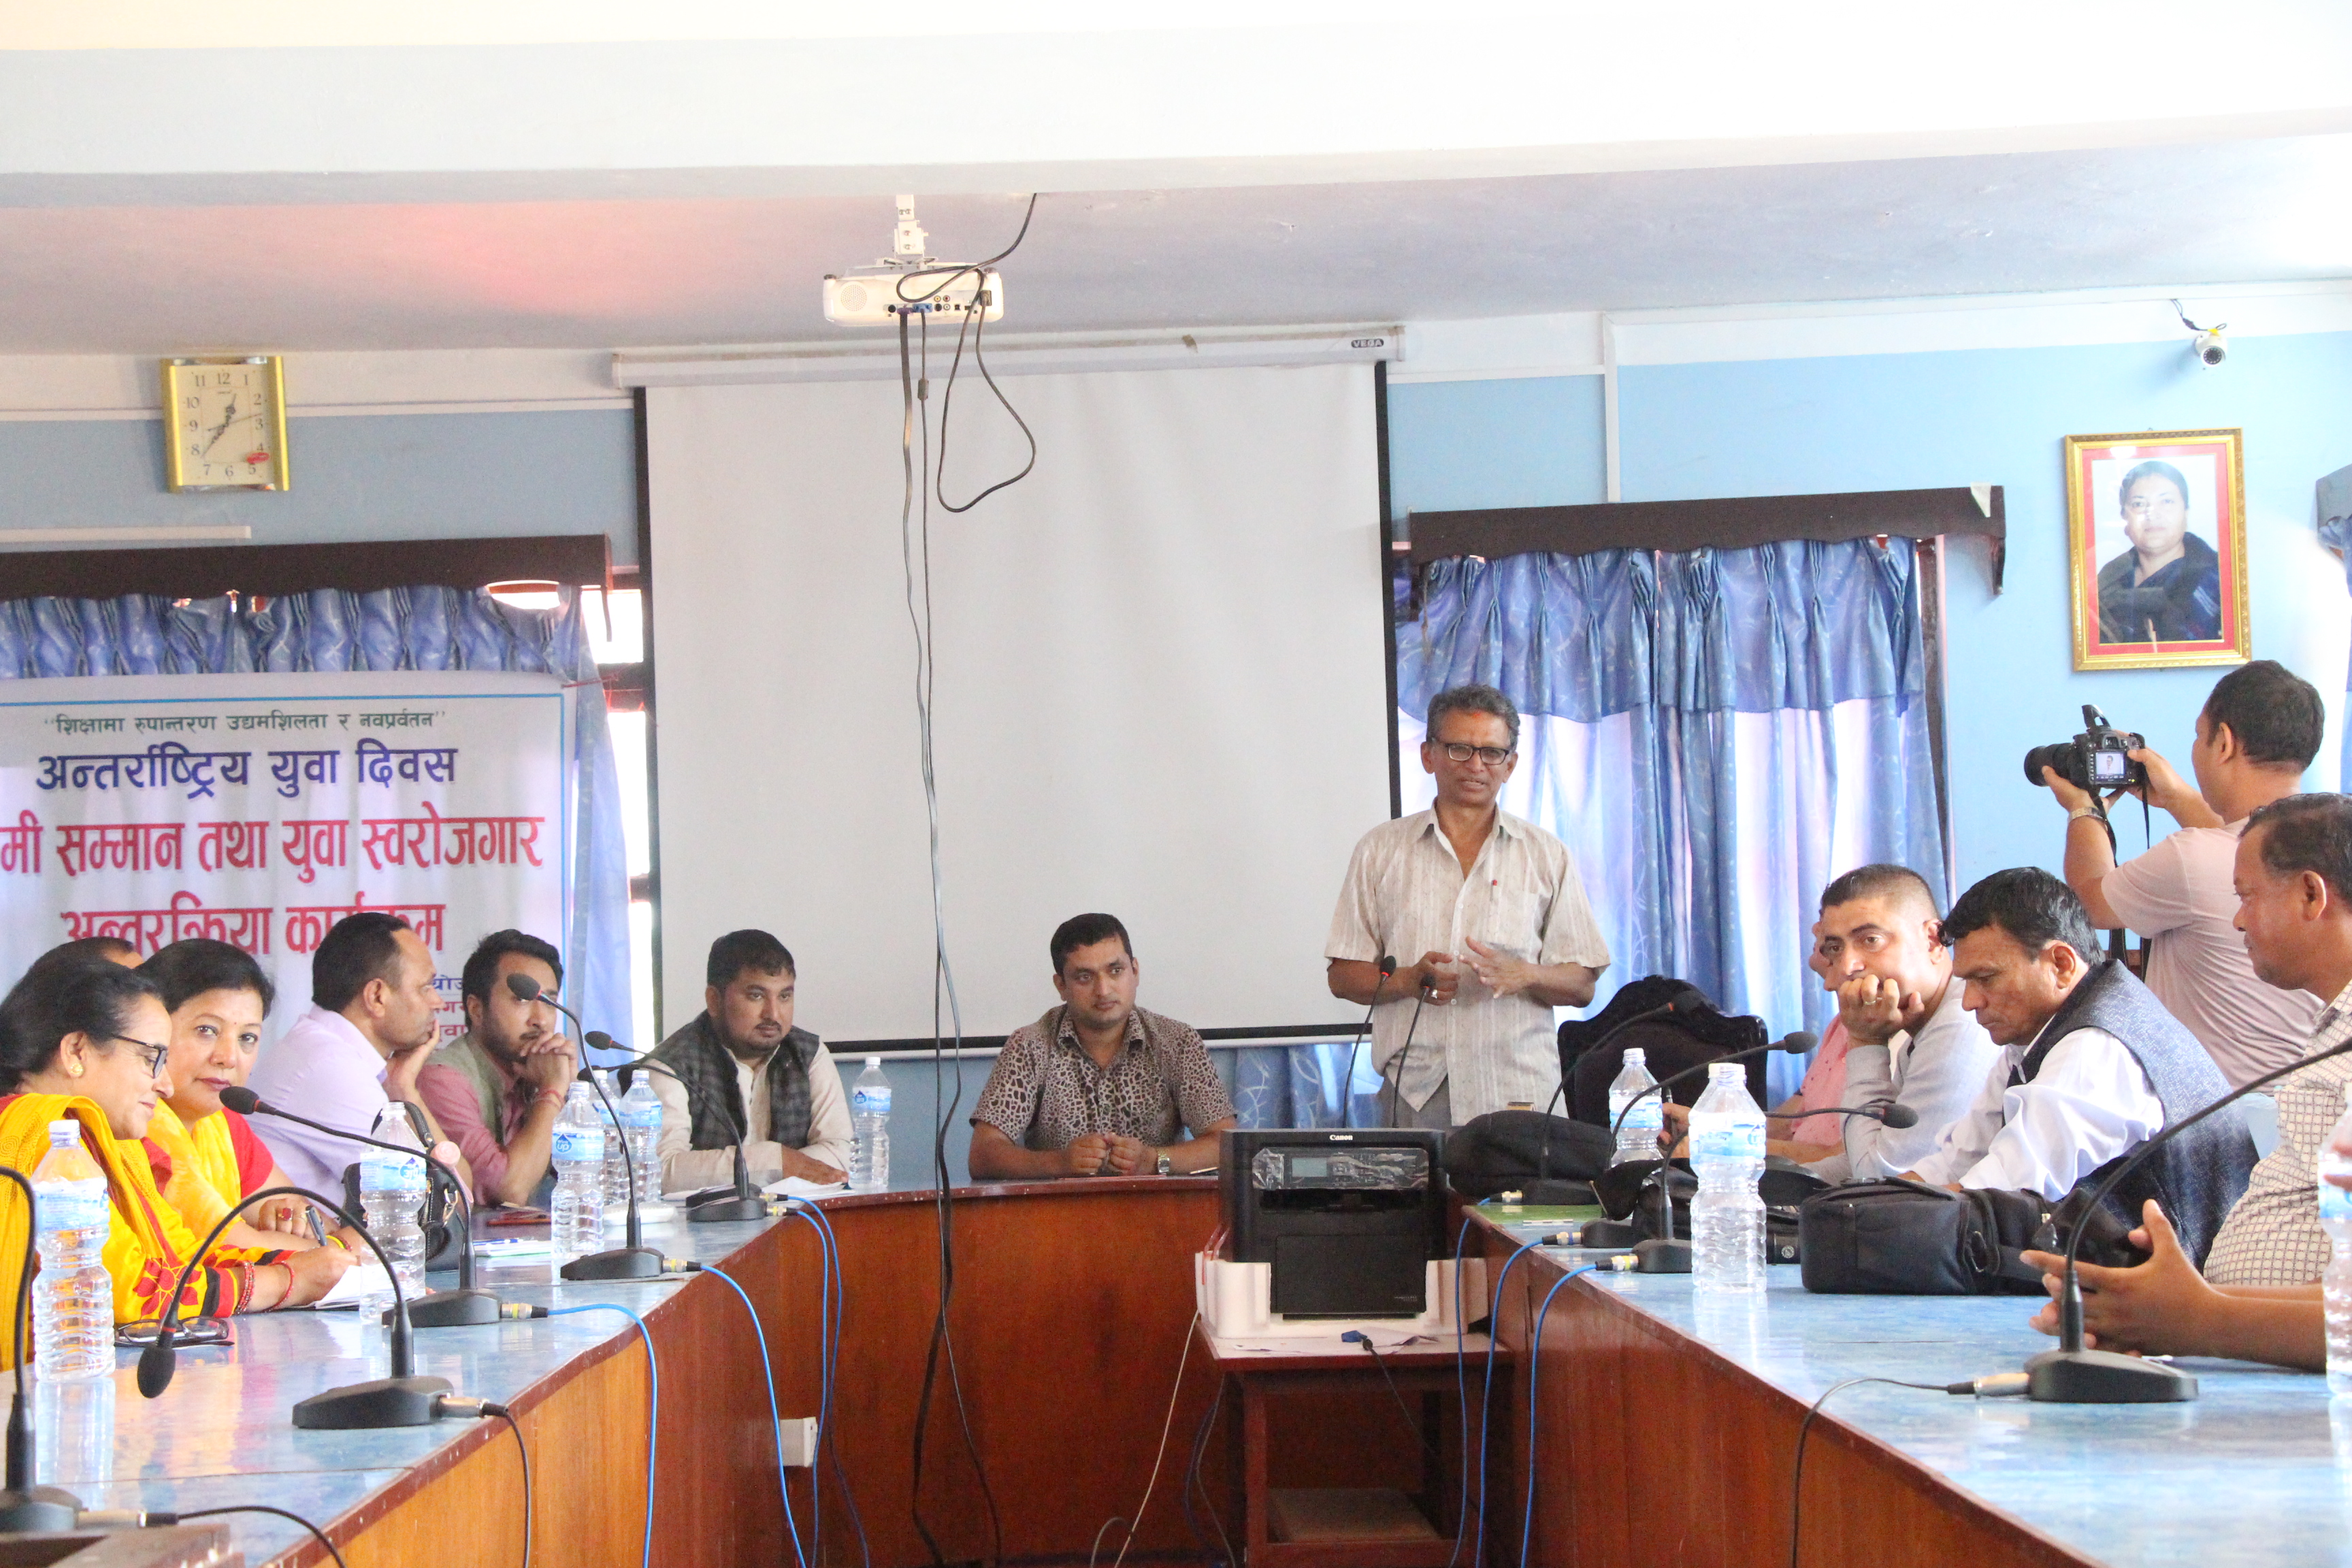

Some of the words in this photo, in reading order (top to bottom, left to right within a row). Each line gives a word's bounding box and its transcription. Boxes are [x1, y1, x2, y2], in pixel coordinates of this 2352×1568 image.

[195, 375, 206, 387] 11
[217, 373, 231, 385] 12
[244, 374, 248, 386] 1
[186, 397, 199, 409] 10
[254, 393, 261, 406] 2
[189, 420, 199, 432] 9
[255, 419, 263, 431] 3
[191, 444, 200, 456] 8
[203, 464, 211, 476] 7
[225, 466, 234, 477] 6
[338, 714, 351, 731] र
[267, 750, 340, 798] युवा
[355, 738, 459, 789] दिवस
[56, 823, 185, 877] सम्मान
[198, 821, 269, 872] तथा
[282, 820, 349, 884] युवा
[362, 800, 545, 870] स्वरोजगार
